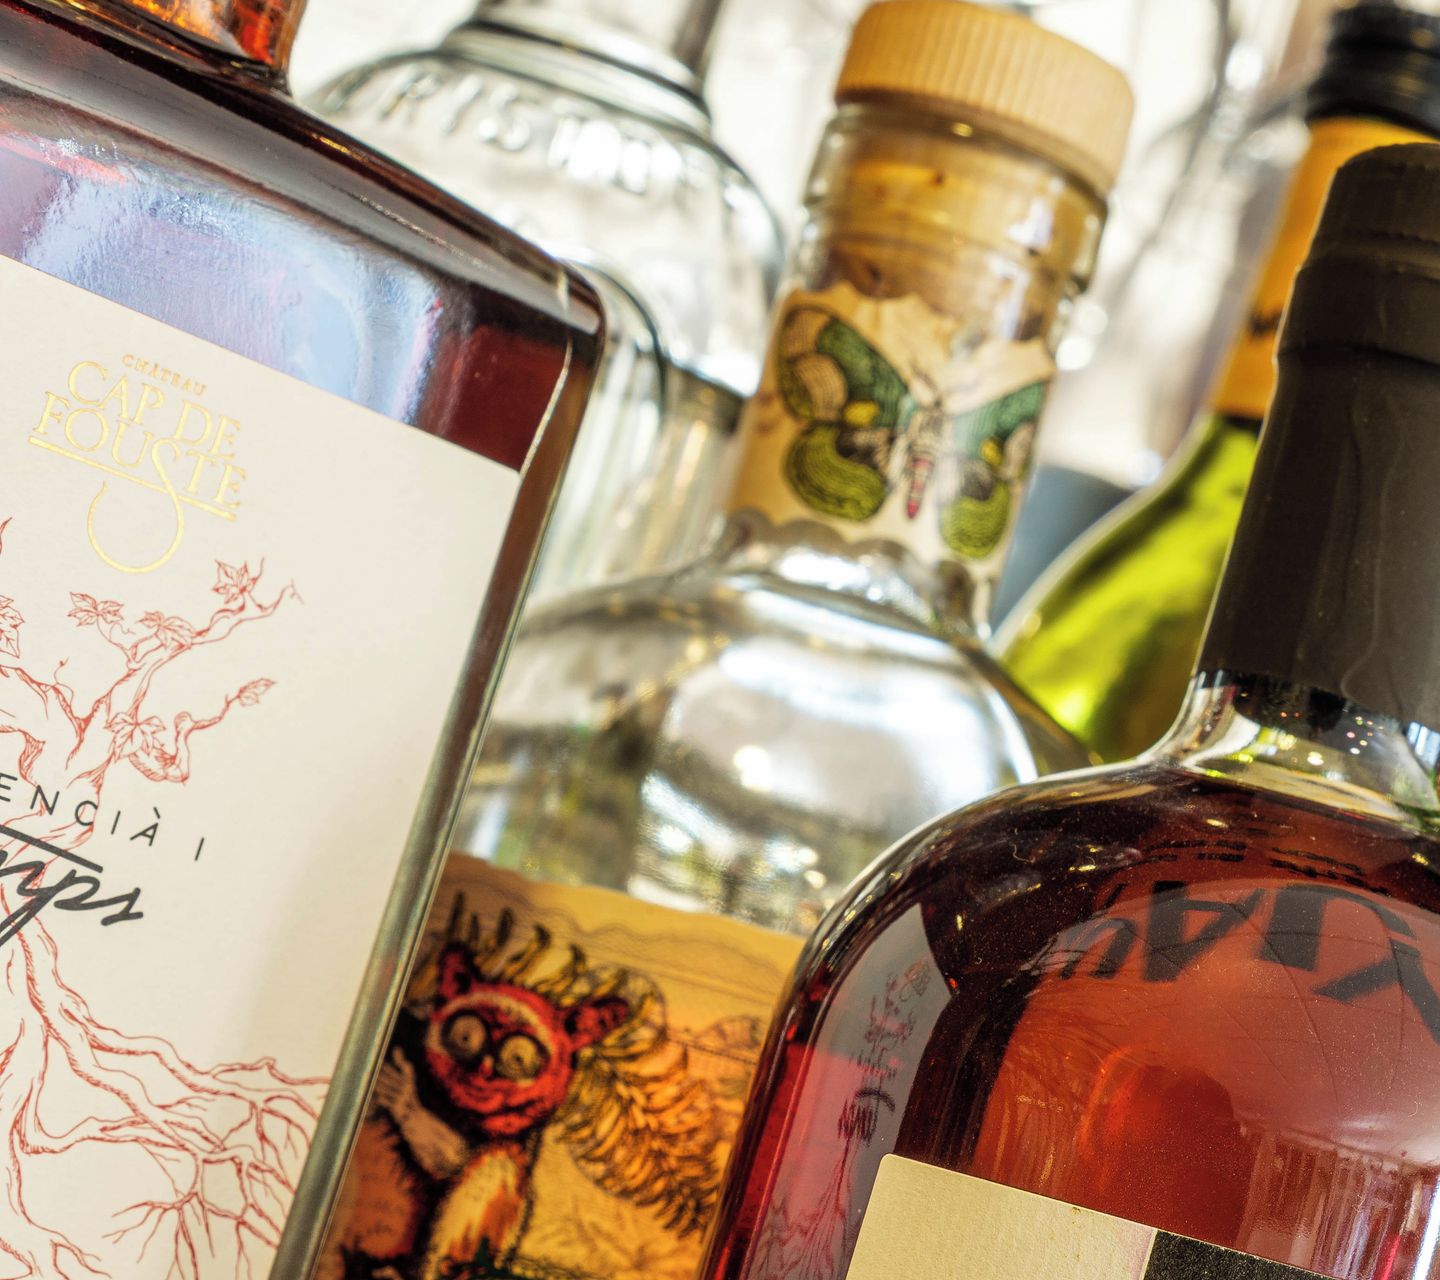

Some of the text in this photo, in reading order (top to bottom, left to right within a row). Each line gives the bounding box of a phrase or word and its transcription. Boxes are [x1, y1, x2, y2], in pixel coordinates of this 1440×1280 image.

[67, 360, 242, 460] CAP DE
[122, 354, 208, 397] CHÂTEAU
[33, 391, 247, 573] FOUSTE
